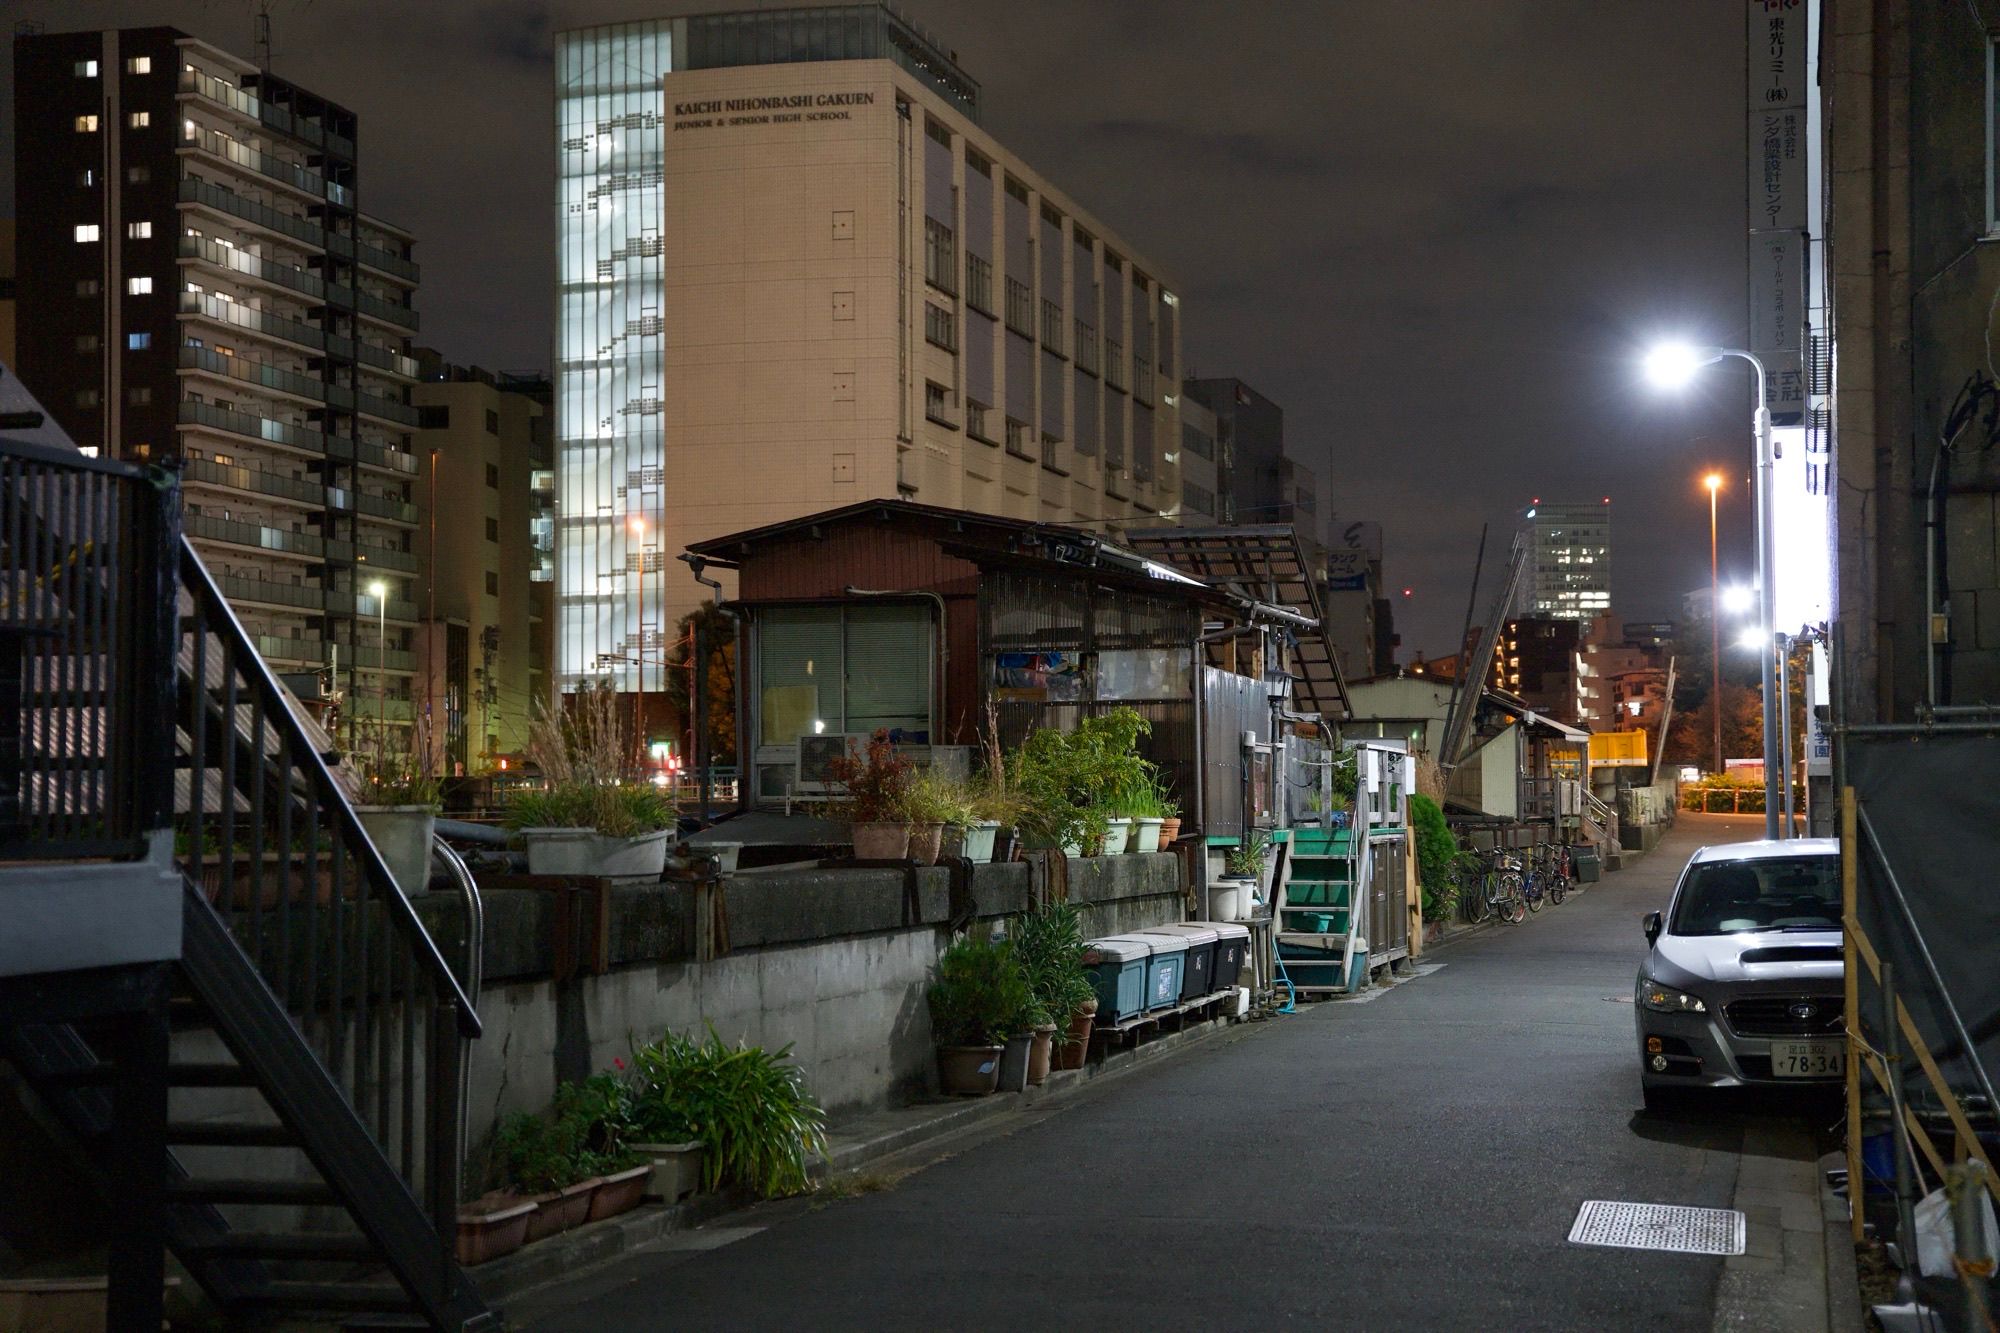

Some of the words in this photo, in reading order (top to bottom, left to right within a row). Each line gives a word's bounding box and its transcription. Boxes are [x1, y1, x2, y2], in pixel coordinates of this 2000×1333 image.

[674, 101, 722, 116] KAICHI
[726, 95, 813, 112] NIHONBASHI
[816, 92, 874, 107] GAKUEN
[674, 119, 713, 132] JUNIOR
[716, 118, 725, 128] &
[729, 114, 769, 126] SENIOR
[773, 113, 802, 124] HIGH
[806, 111, 851, 122] SCHOOL
[1784, 114, 1796, 160] 株式会社
[1788, 1056, 1838, 1072] 78-34
